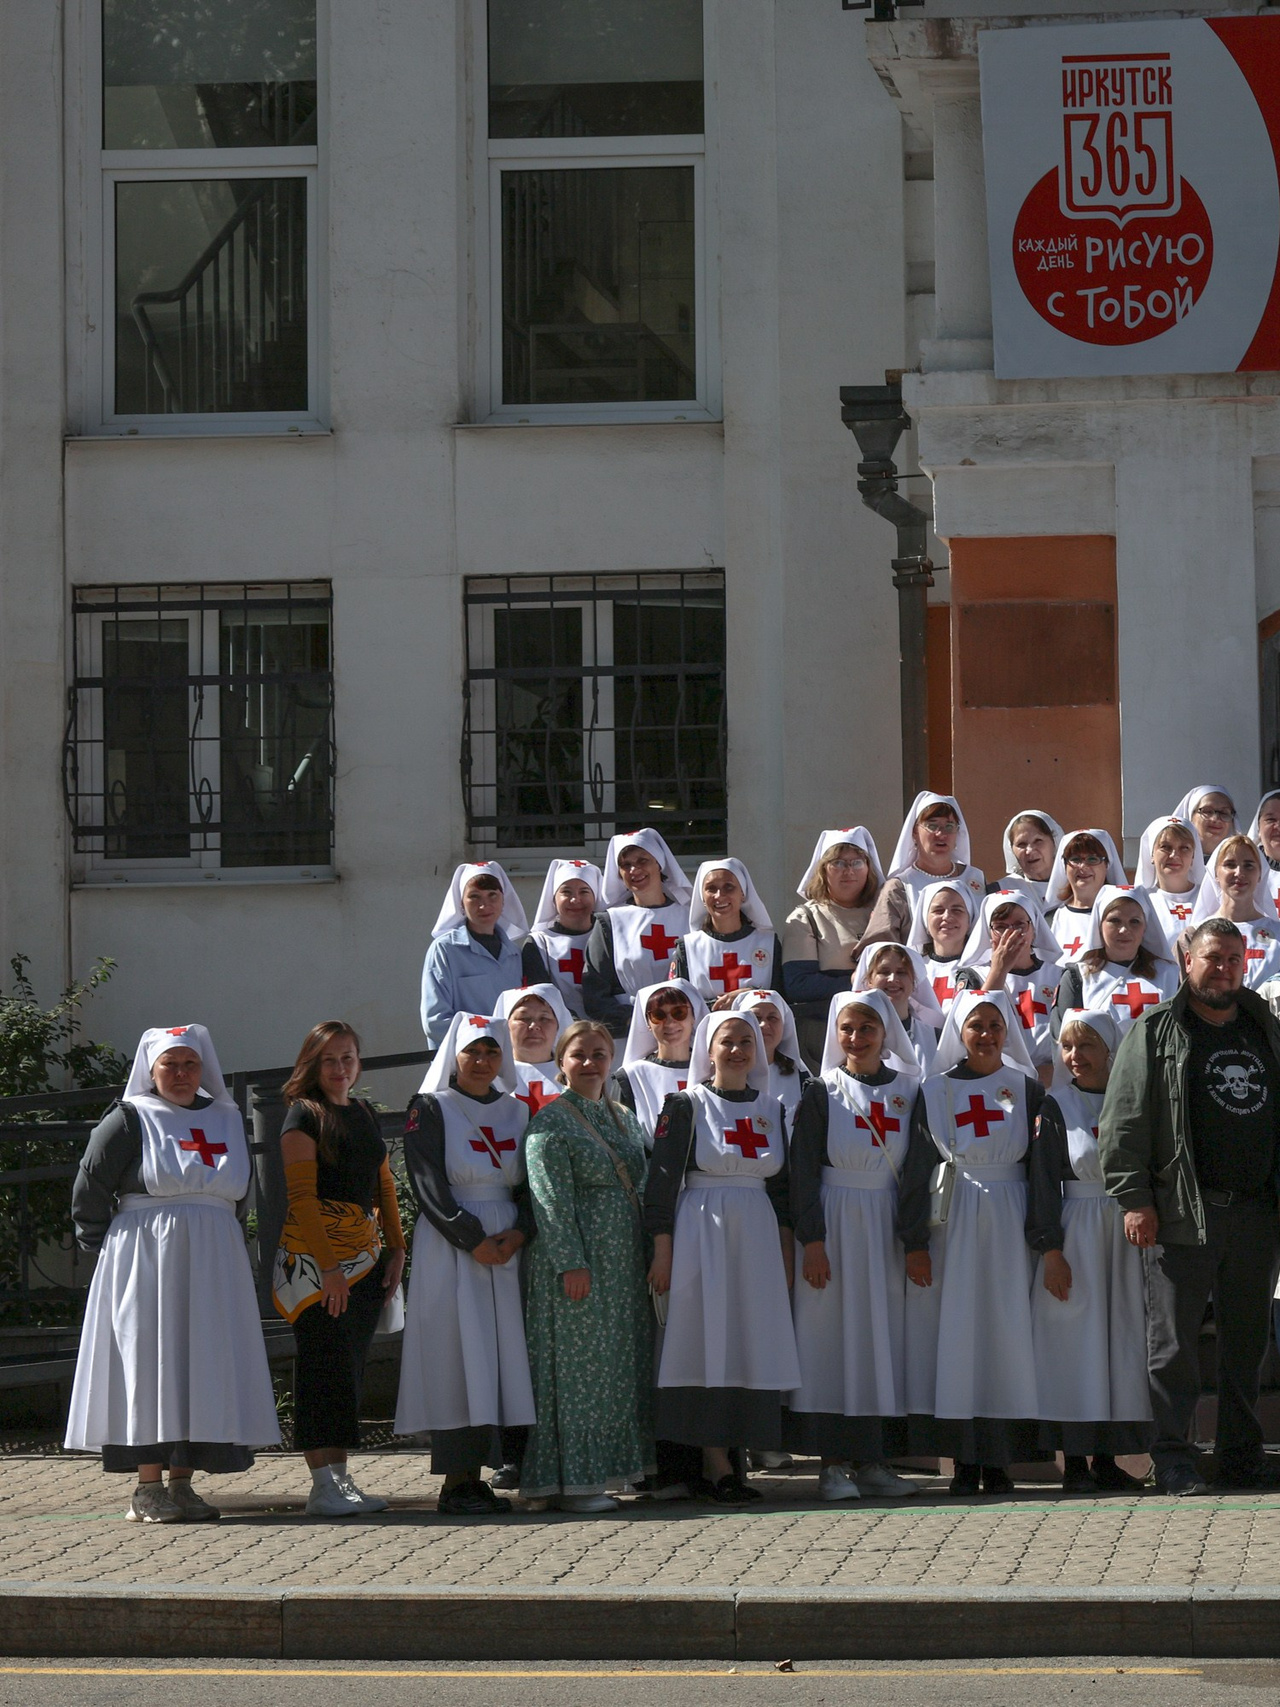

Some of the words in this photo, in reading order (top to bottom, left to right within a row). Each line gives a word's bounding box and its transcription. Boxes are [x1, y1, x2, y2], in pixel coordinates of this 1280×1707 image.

[1062, 67, 1172, 107] ИРКУТСК
[1080, 111, 1157, 197] 365
[1018, 234, 1078, 253] КАЖДЫЙ
[1037, 253, 1074, 272] ДЕНЬ
